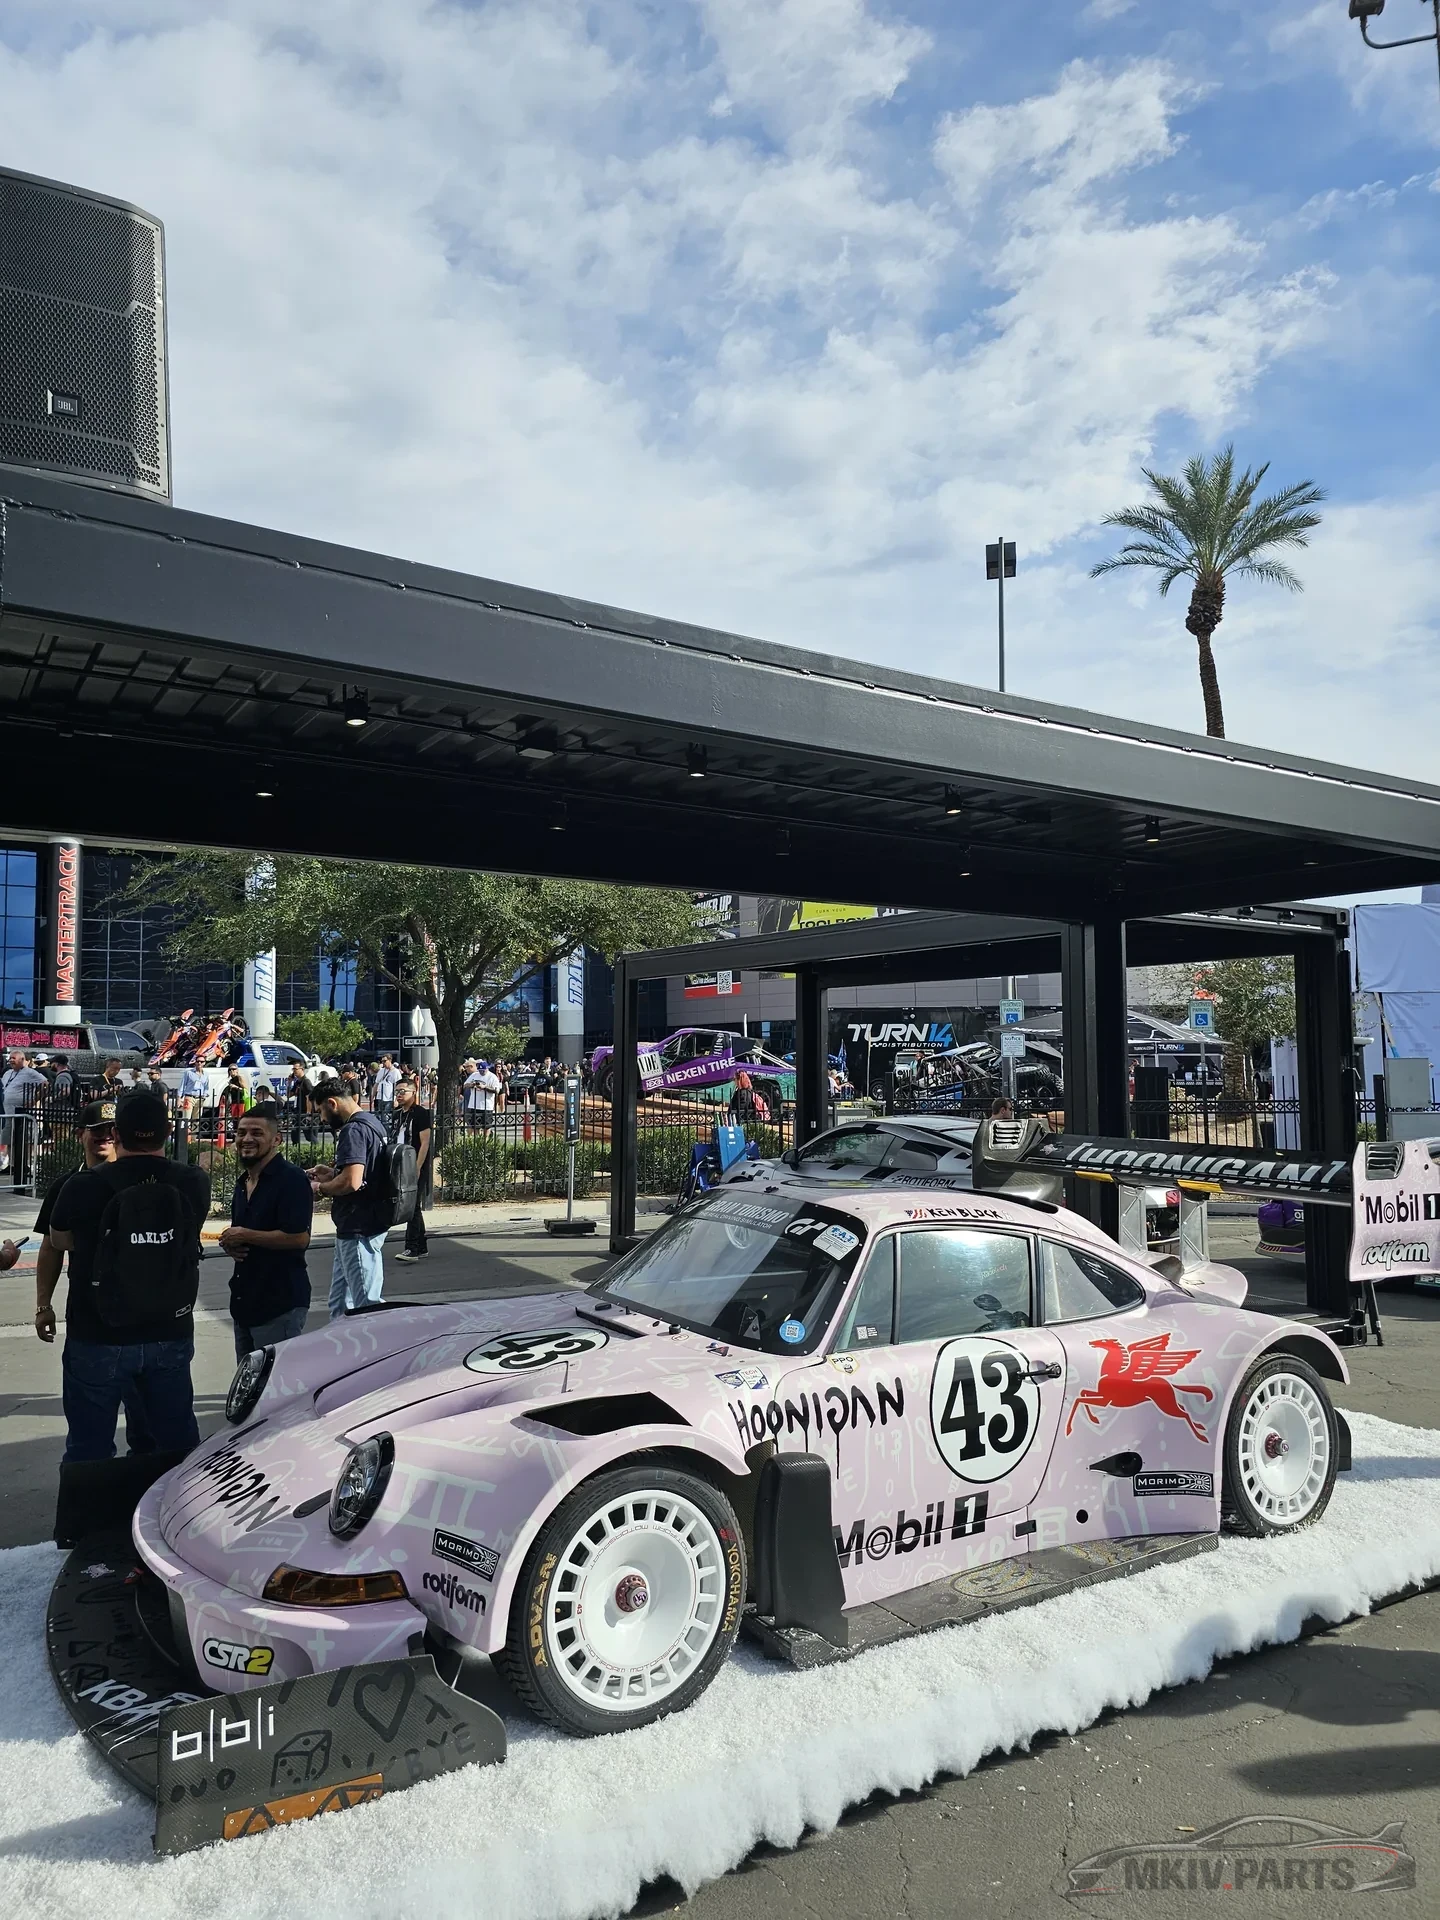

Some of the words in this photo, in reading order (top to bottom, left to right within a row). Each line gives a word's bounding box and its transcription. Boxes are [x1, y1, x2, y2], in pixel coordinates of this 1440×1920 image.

[57, 400, 74, 411] JBL
[720, 895, 732, 912] UP
[56, 847, 77, 1002] MASTERTRACK
[800, 917, 866, 929] TOOLB
[847, 1023, 953, 1047] TURN14
[666, 1066, 707, 1084] NEXEN
[708, 1057, 736, 1072] TIRE
[902, 1175, 957, 1188] ROTIFORM
[704, 1200, 741, 1214] GRAN
[733, 1203, 790, 1224] TURISMO
[926, 1208, 957, 1217] KEN
[957, 1208, 1003, 1219] BLOCK
[1365, 1194, 1419, 1224] Mobil
[130, 1228, 174, 1244] OAKLEY
[1361, 1239, 1431, 1271] rotiform
[479, 1332, 597, 1369] 43
[831, 1356, 854, 1365] PPO
[940, 1350, 1029, 1462] 43
[832, 1501, 945, 1569] Mobil
[422, 1572, 487, 1616] rotiform
[721, 1543, 741, 1632] YOKOHAMA
[530, 1552, 558, 1667] ADVAN
[577, 1604, 582, 1615] 43
[203, 1639, 272, 1674] CSR2
